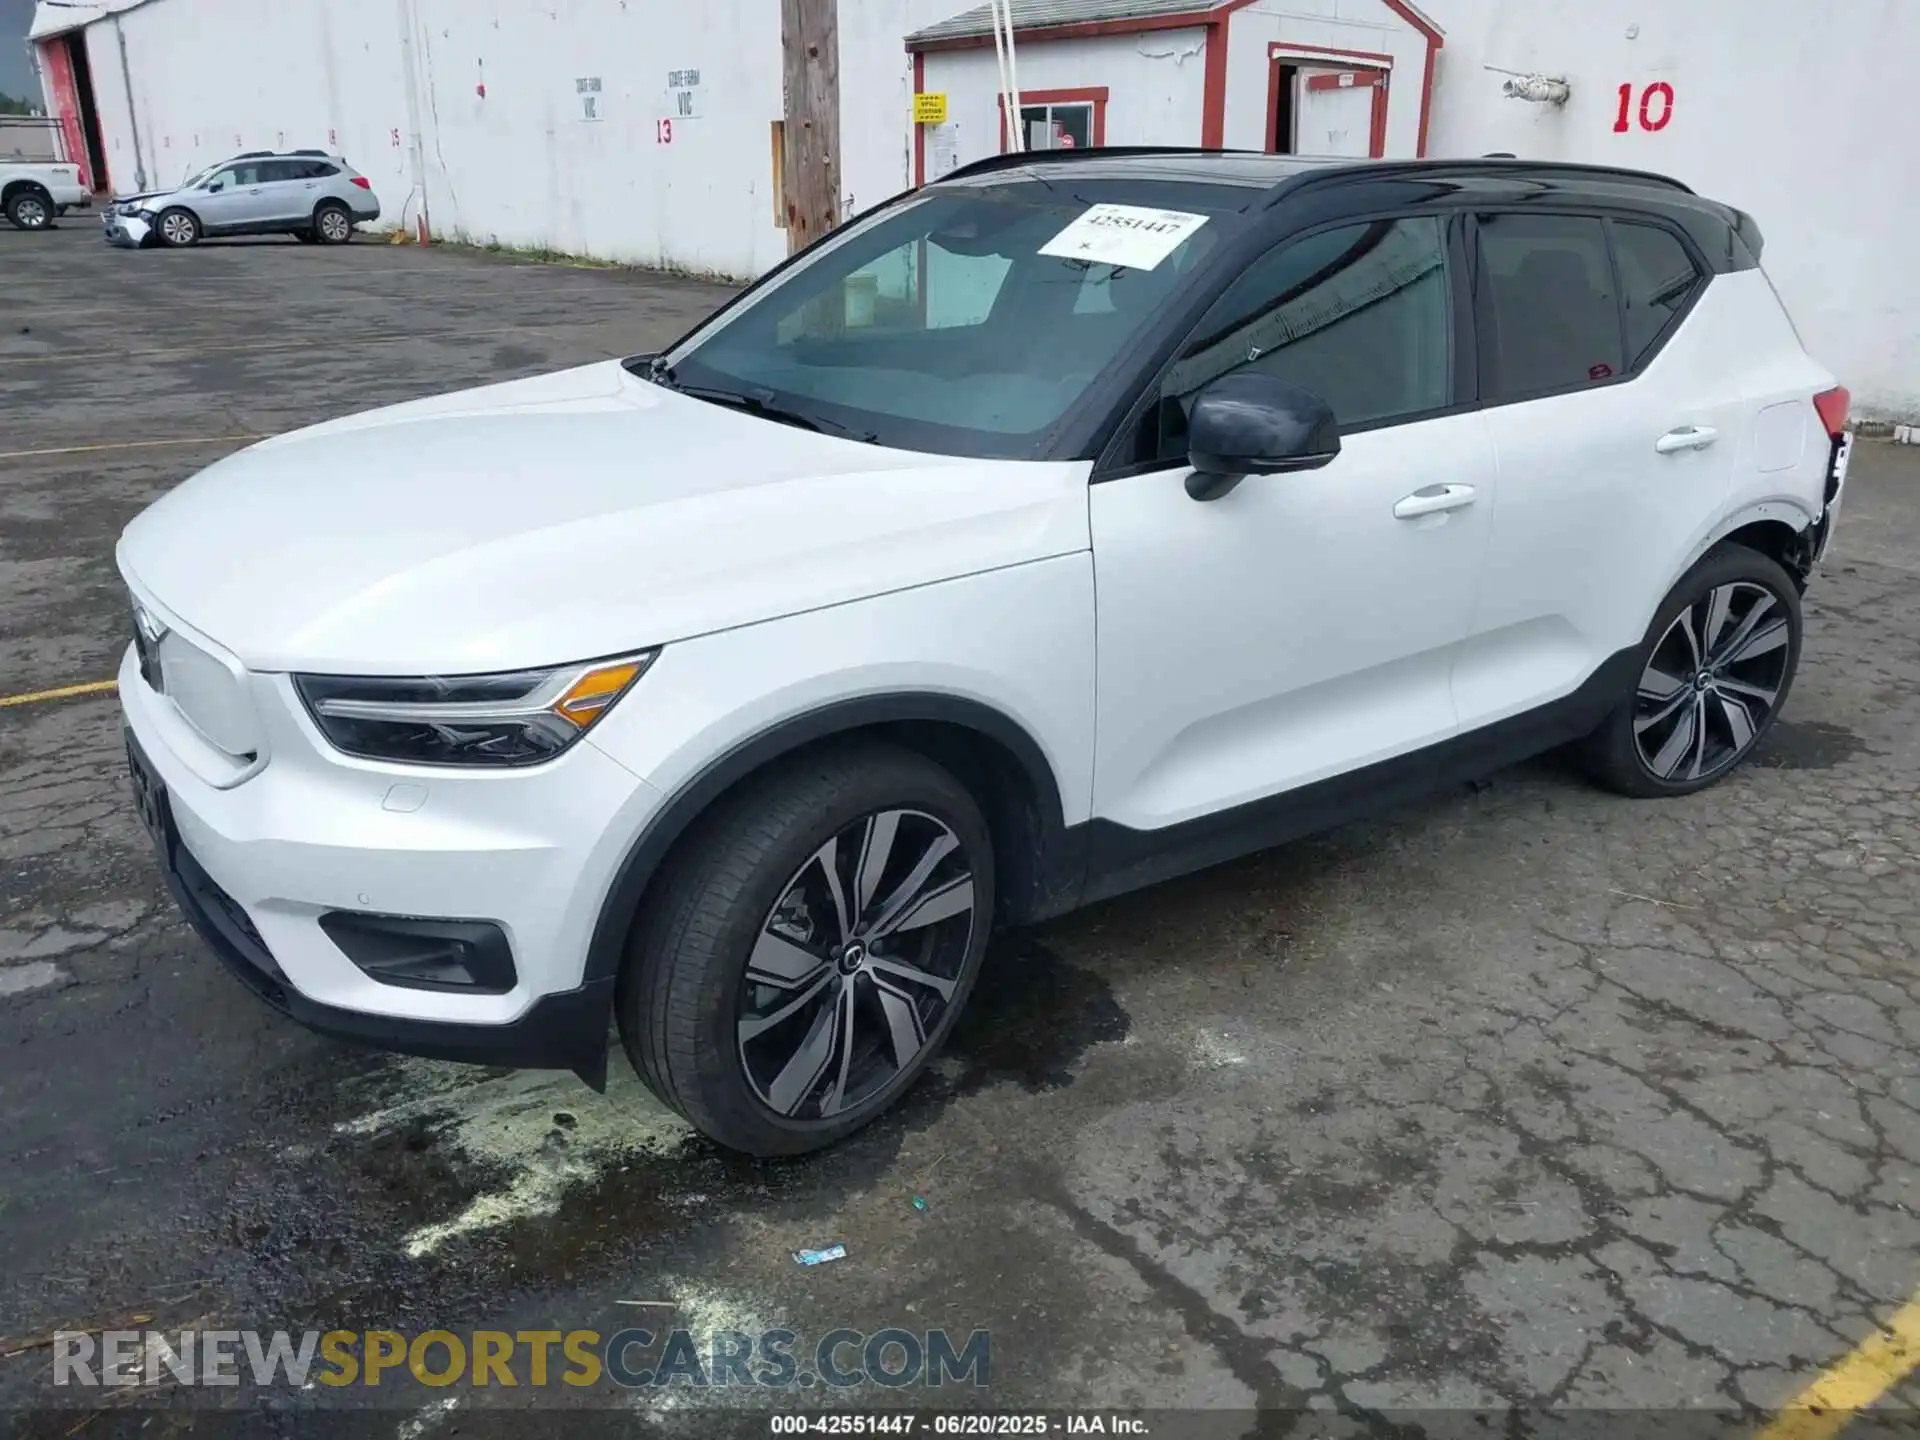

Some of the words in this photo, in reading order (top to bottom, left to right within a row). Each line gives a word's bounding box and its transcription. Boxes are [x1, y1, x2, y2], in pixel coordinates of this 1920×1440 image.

[677, 91, 692, 116] VIC
[1613, 81, 1674, 132] 10
[656, 118, 672, 144] 13
[1087, 215, 1181, 234] 42551447
